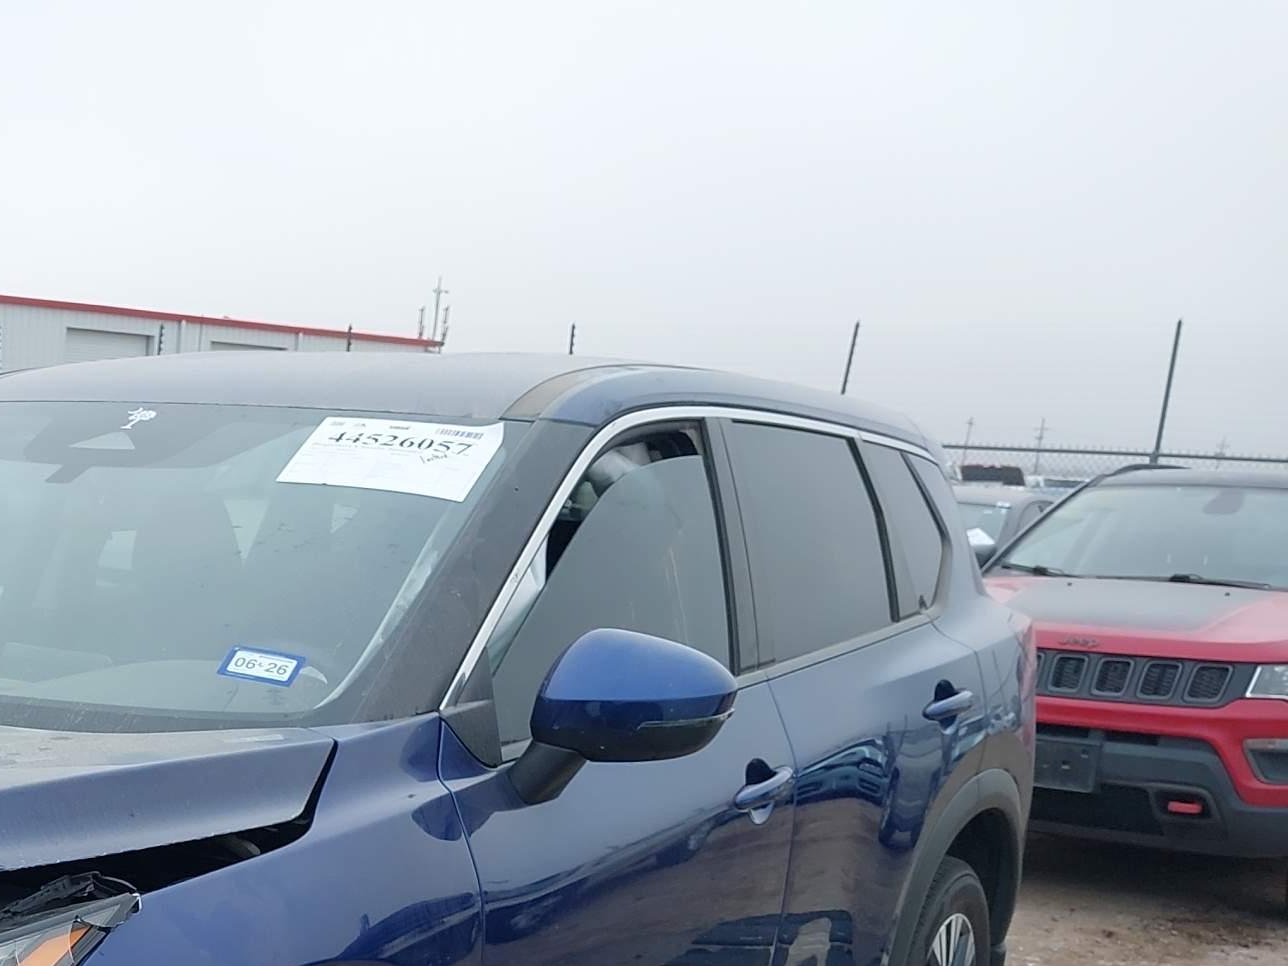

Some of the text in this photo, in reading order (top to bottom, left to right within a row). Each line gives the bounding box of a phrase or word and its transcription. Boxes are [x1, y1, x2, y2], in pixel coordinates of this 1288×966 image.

[327, 430, 473, 456] 44526057
[234, 656, 289, 676] 06 26
